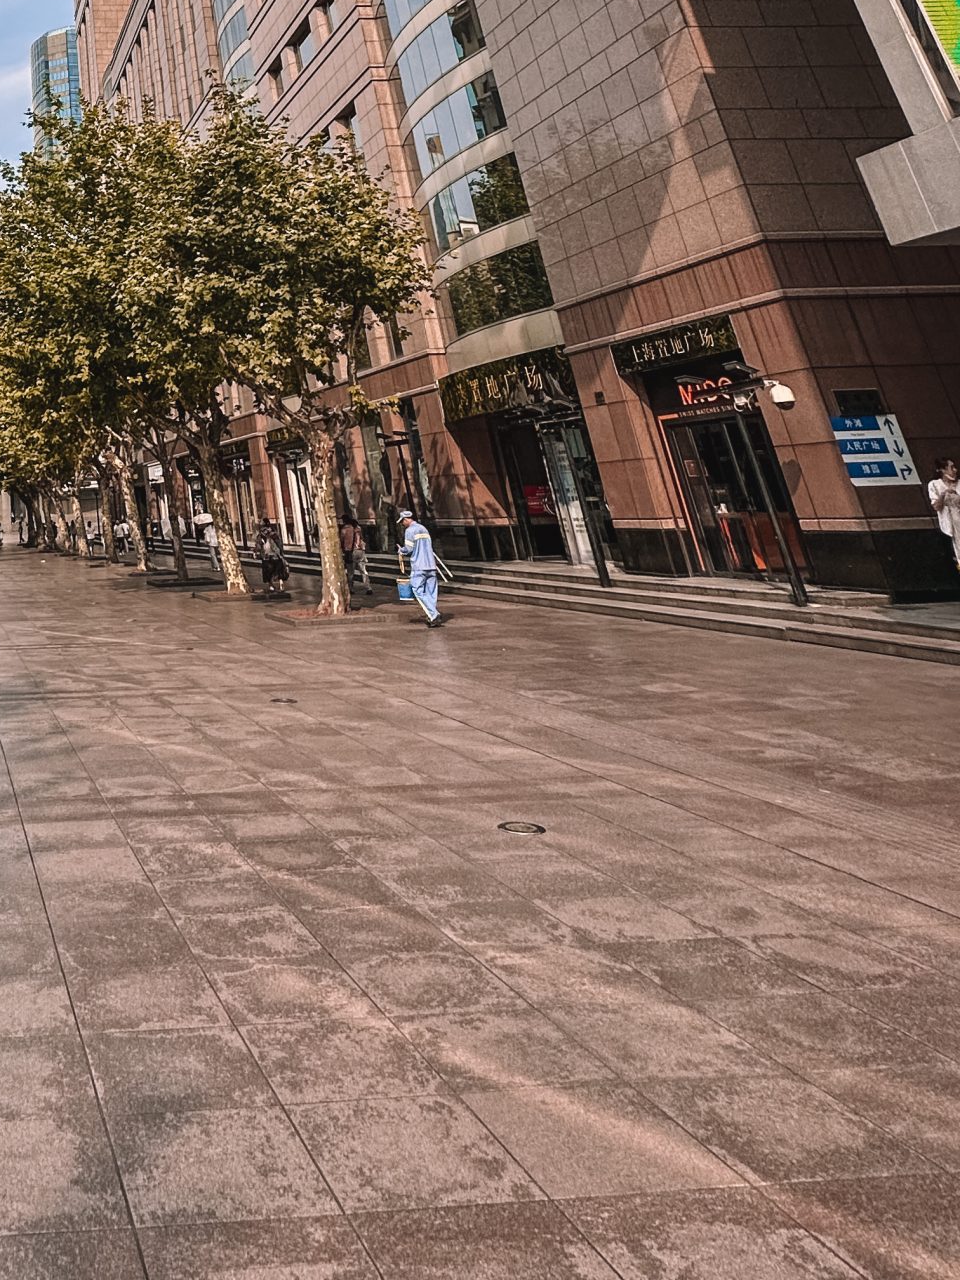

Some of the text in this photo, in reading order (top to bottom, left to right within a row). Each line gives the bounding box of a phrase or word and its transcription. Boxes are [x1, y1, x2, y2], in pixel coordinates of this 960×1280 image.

[631, 327, 715, 363] 上海置地广场
[846, 440, 881, 451] 人民广场
